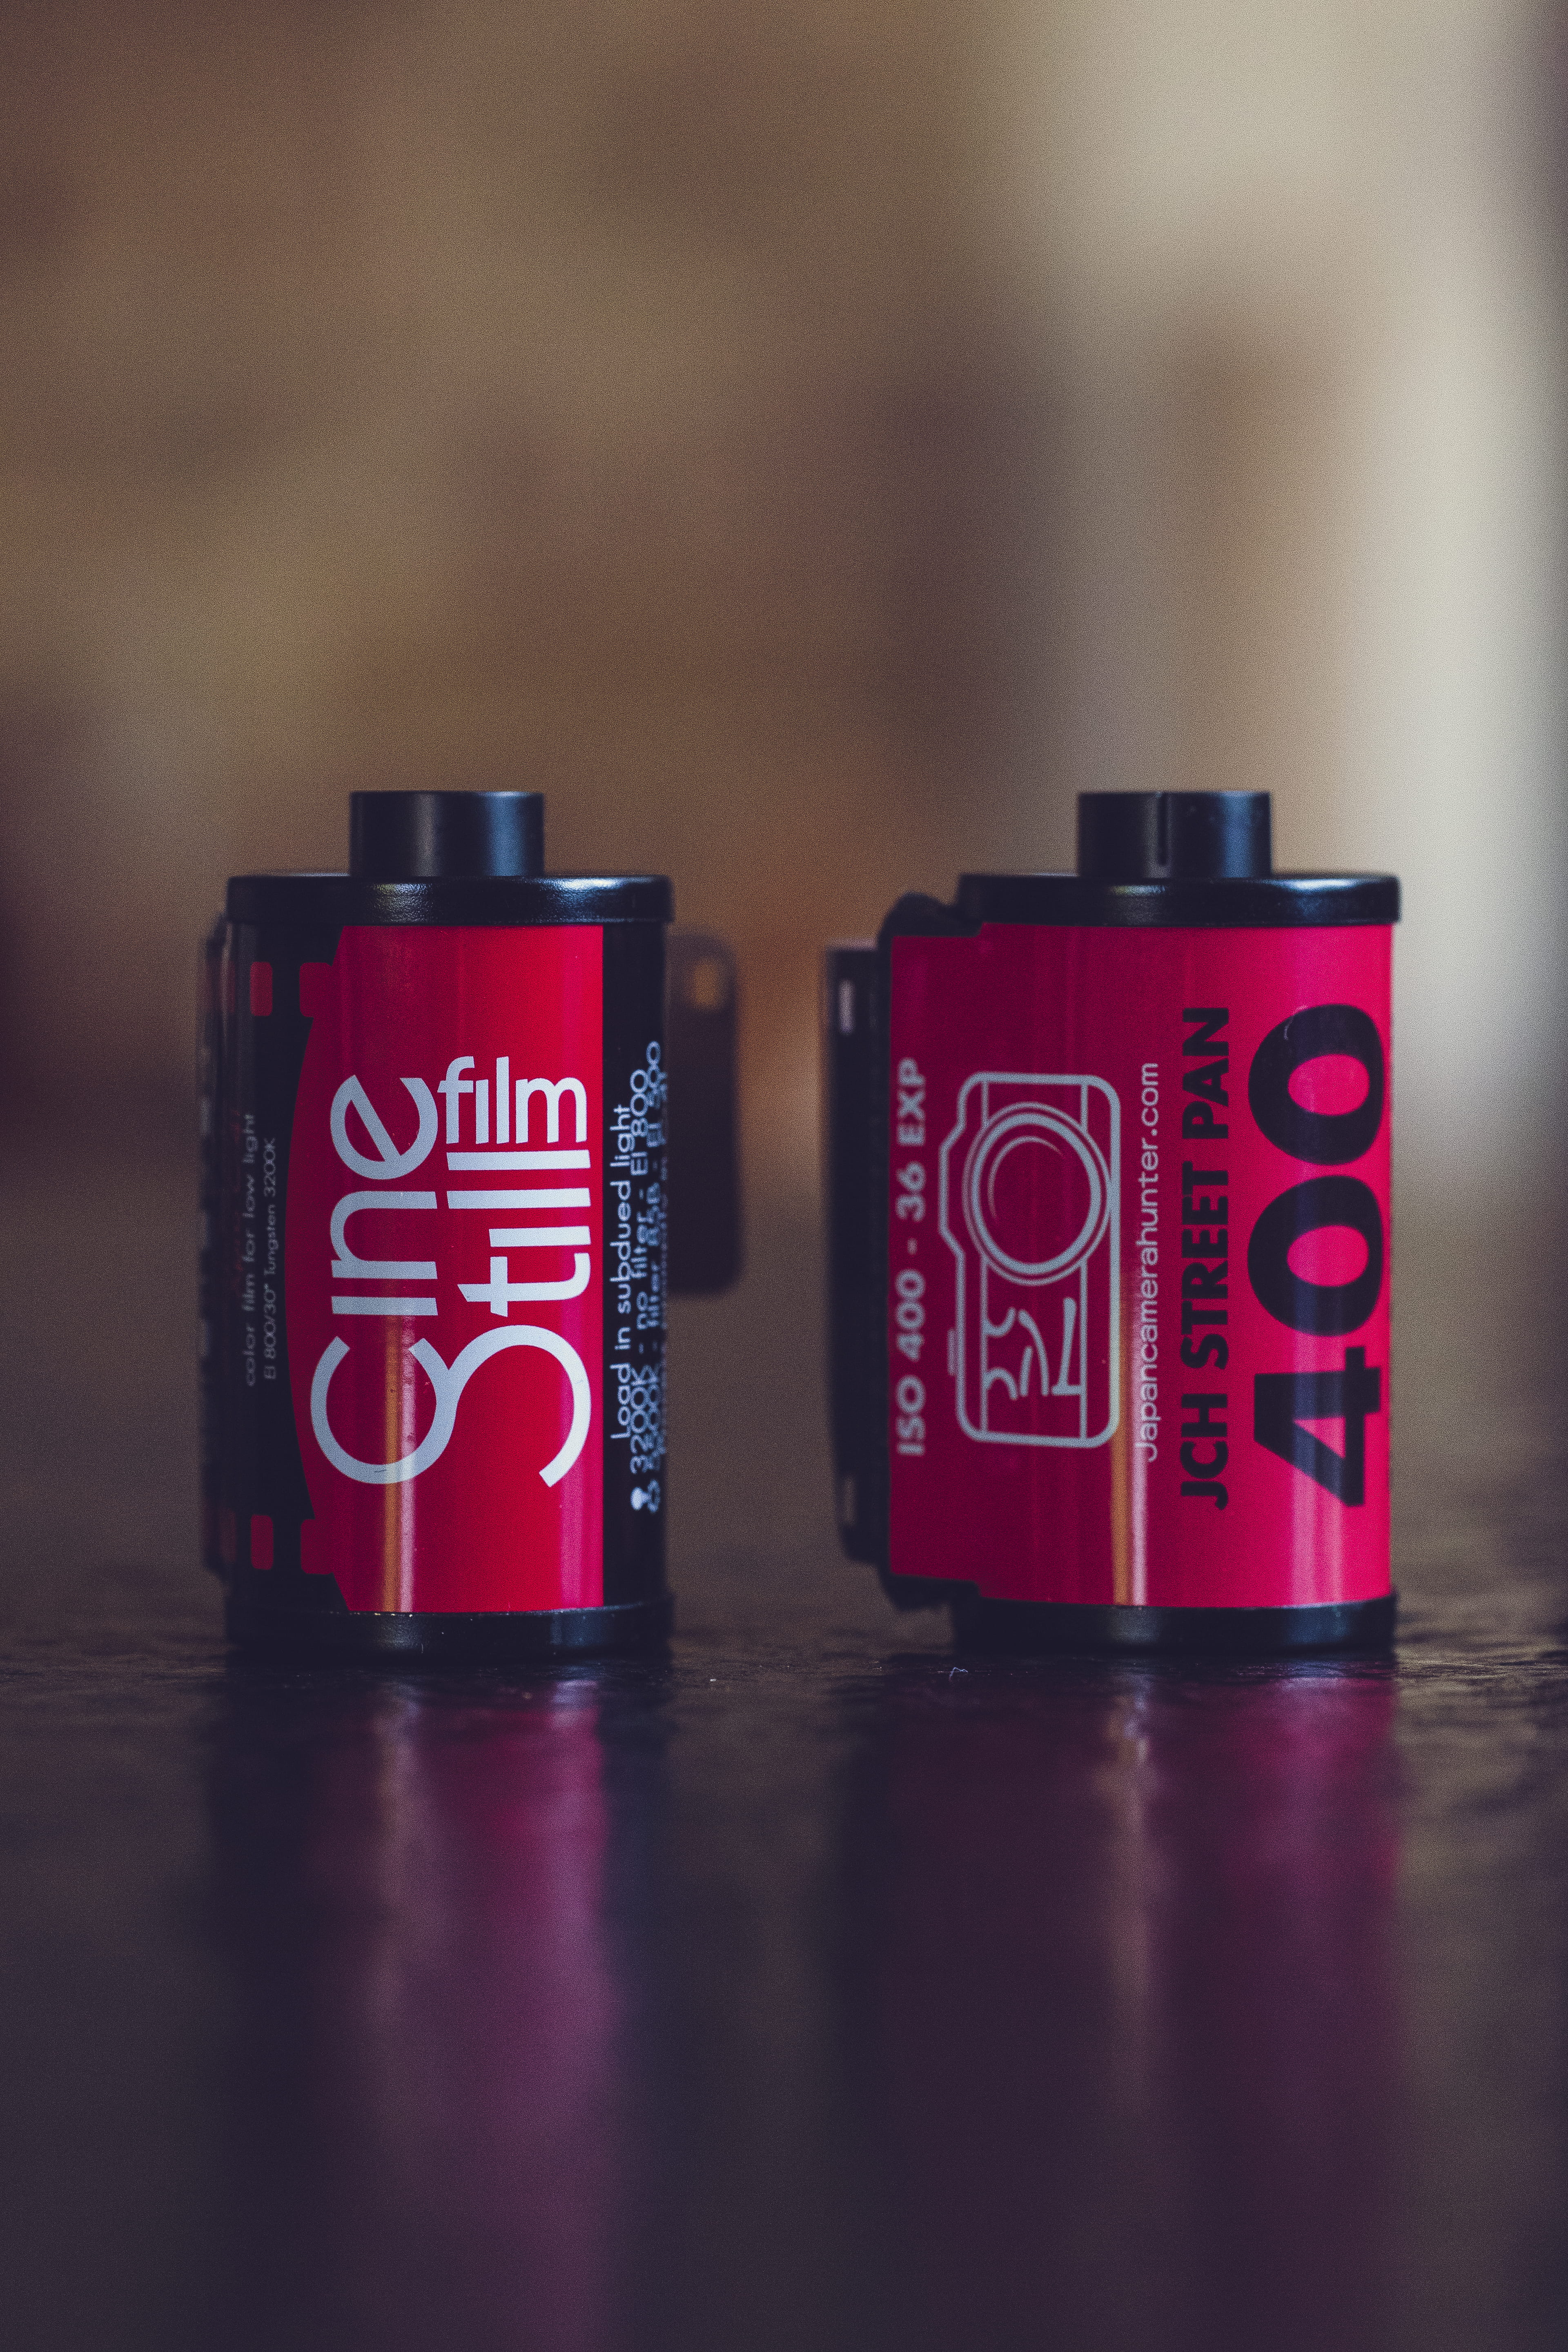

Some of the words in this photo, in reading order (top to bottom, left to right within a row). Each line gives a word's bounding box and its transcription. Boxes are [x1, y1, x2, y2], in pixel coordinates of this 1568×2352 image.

[437, 1055, 588, 1145] film
[629, 1069, 649, 1137] 800
[897, 1057, 926, 1147] EXP
[1181, 1006, 1230, 1140] PAN
[241, 1113, 259, 1164] light
[263, 1137, 277, 1198] 3200K
[609, 1104, 635, 1167] light
[630, 1151, 649, 1176] EI
[241, 1173, 256, 1218] low
[897, 1162, 927, 1222] 36
[241, 1229, 256, 1263] for
[263, 1204, 279, 1275] Tungsten
[609, 1180, 631, 1314] subdued
[630, 1211, 648, 1279] filter
[1180, 1161, 1230, 1369] STREET
[1246, 1003, 1385, 1508] 400
[241, 1272, 256, 1312] film
[310, 1074, 452, 1485] Cine
[636, 1291, 648, 1330] no
[433, 1148, 592, 1488] Still
[613, 1326, 631, 1350] in
[897, 1270, 927, 1362] 400
[241, 1322, 256, 1387] color
[609, 1362, 631, 1439] Load
[629, 1365, 648, 1474] 3200K
[896, 1375, 926, 1457] ISO
[1180, 1393, 1230, 1510] JCH
